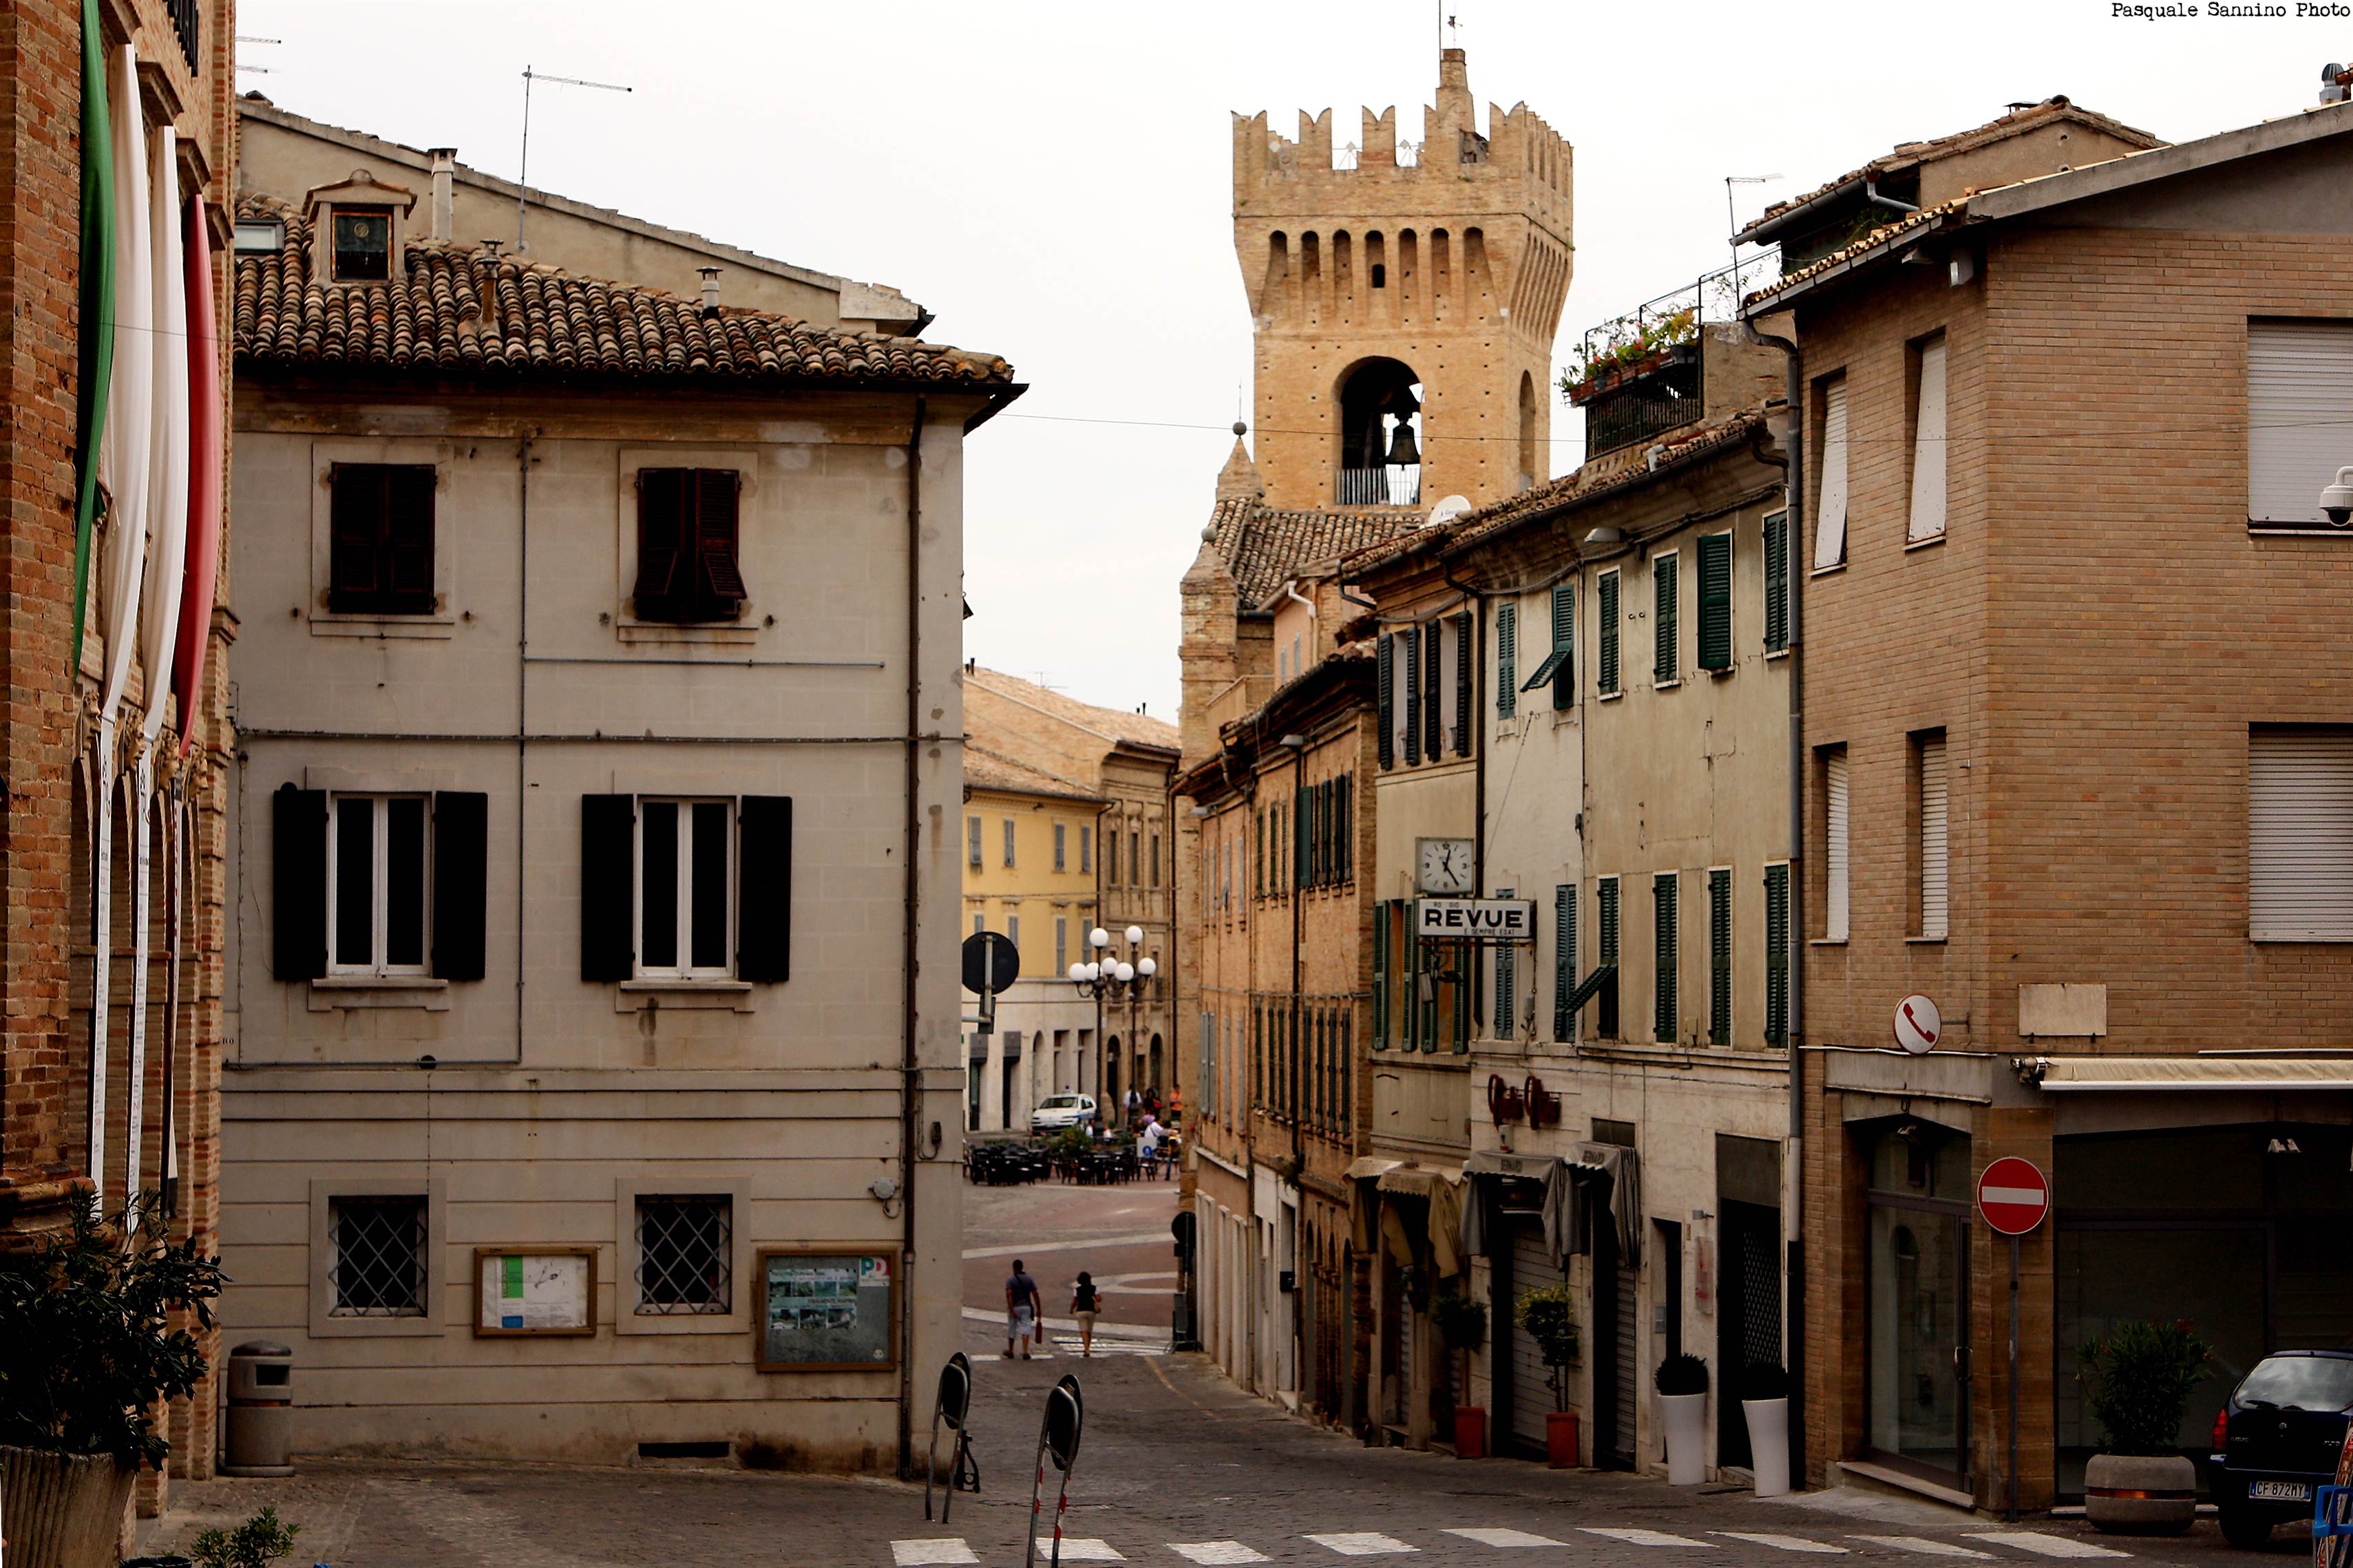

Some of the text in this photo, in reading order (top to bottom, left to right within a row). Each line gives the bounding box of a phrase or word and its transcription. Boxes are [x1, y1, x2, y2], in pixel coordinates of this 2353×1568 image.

[1425, 909, 1522, 928] REVUE
[2257, 1482, 2304, 1497] CF 872MY
